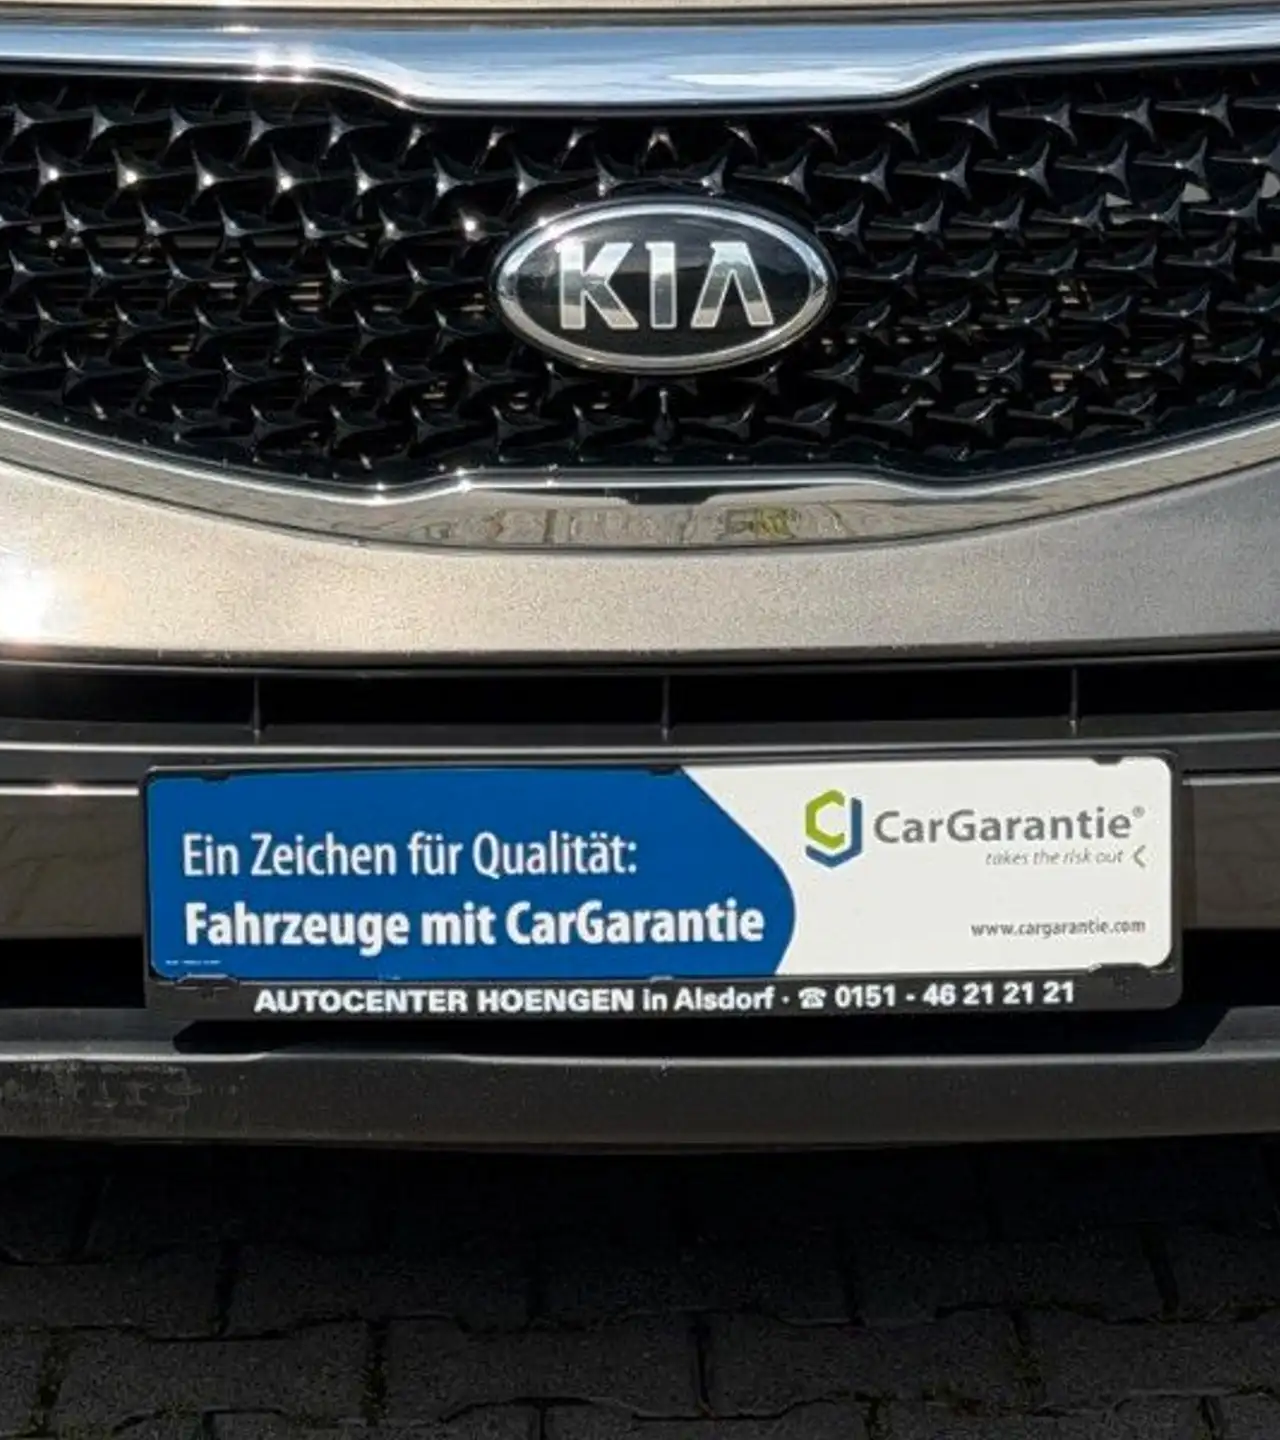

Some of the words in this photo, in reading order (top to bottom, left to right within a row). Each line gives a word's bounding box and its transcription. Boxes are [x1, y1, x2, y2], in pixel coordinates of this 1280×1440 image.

[555, 241, 774, 330] KIA
[182, 833, 239, 877] Ein
[251, 832, 396, 876] Zeichen
[407, 831, 464, 875] für
[472, 831, 638, 879] Qualität:
[985, 849, 1028, 865] takes
[1033, 848, 1060, 865] the
[1063, 847, 1093, 864] risk
[1095, 849, 1124, 864] out
[184, 900, 410, 957] Fahrzeuge
[421, 901, 497, 945] mit
[505, 897, 765, 945] CarGarantie
[970, 917, 1147, 939] www.cargarantie.com
[254, 988, 468, 1014] AUTOCENTER
[477, 987, 634, 1013] HOENGEN
[642, 987, 668, 1011] in
[673, 985, 775, 1010] Alsdorf
[835, 984, 896, 1009] 0151
[923, 982, 956, 1007] 46
[963, 982, 995, 1006] 21
[1003, 981, 1035, 1005] 21
[1043, 980, 1075, 1005] 21
